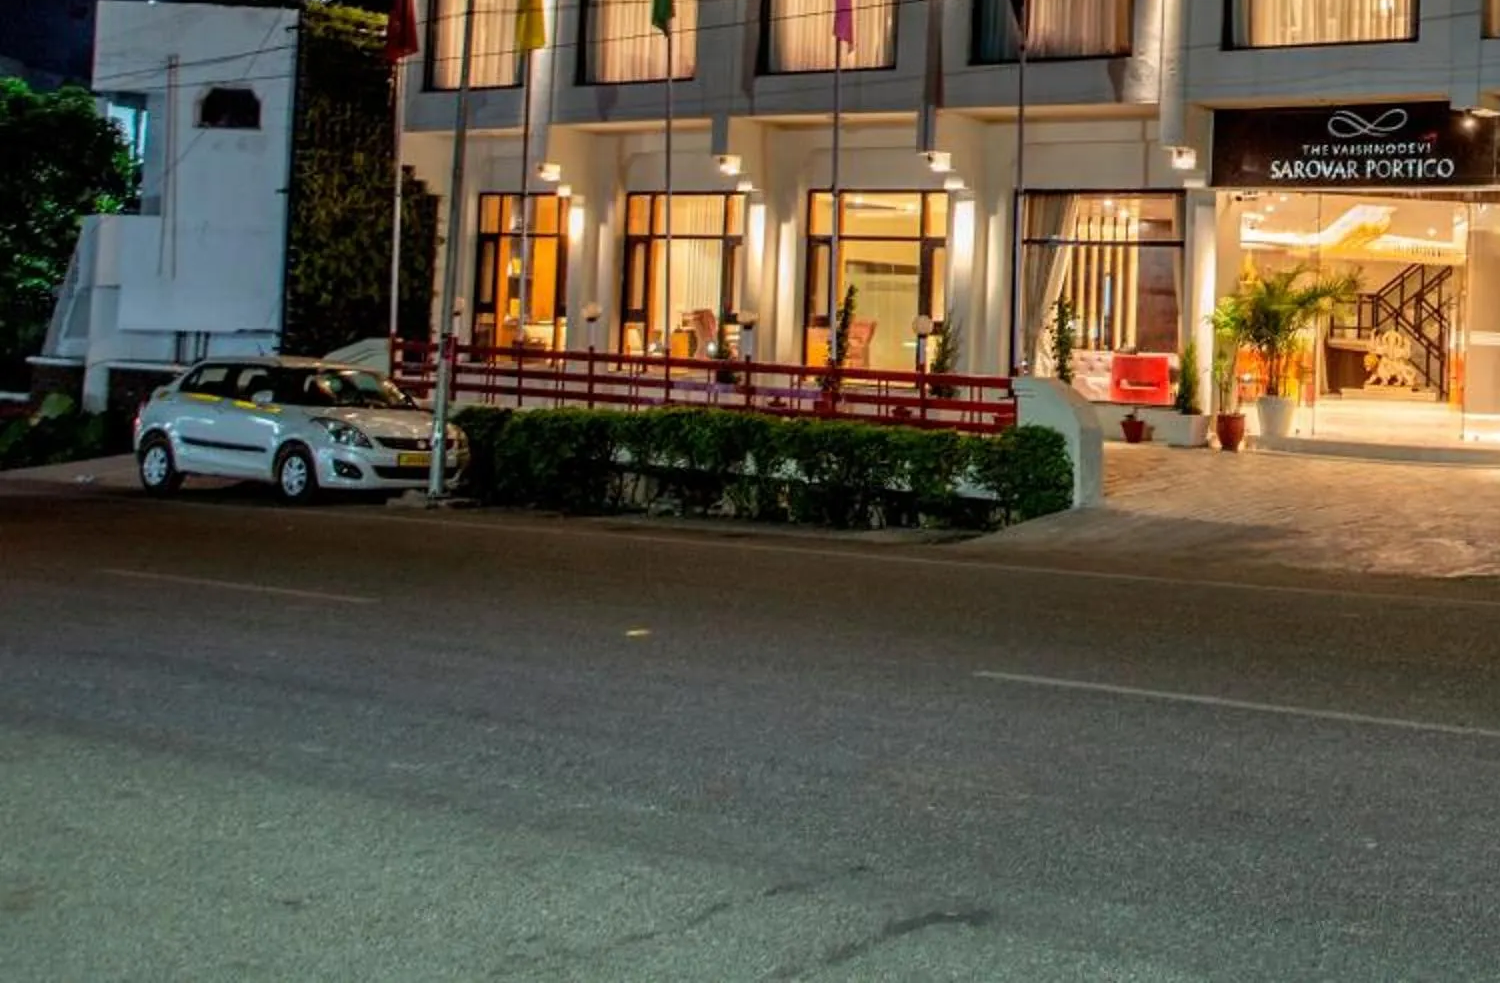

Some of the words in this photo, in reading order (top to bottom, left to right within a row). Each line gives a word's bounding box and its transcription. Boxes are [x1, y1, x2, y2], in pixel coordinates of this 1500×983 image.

[1302, 144, 1329, 155] THE
[1331, 142, 1432, 155] VAISHNODEVI
[1271, 159, 1360, 179] SAROVAR
[1365, 157, 1455, 178] PORTICO
